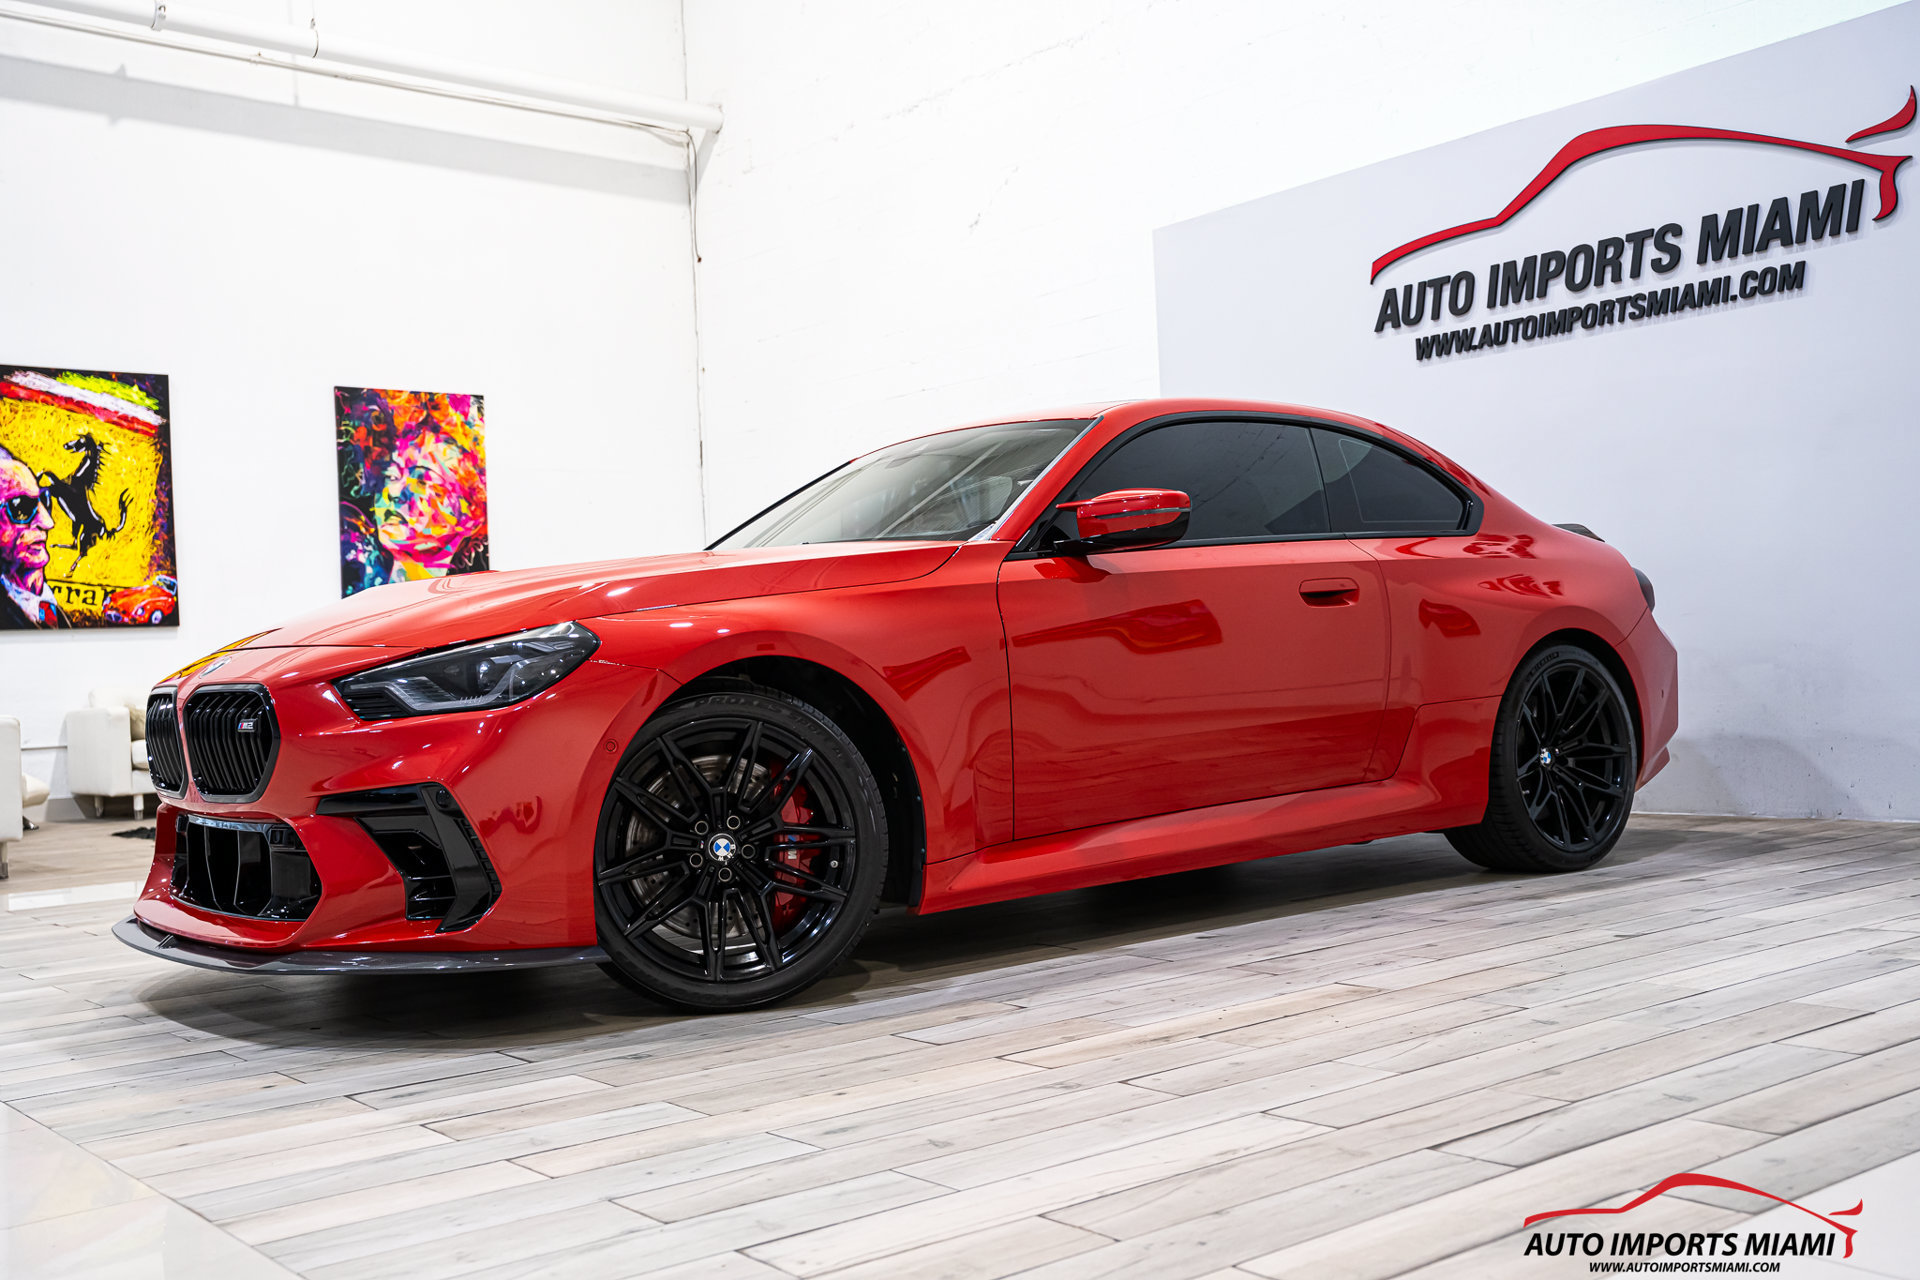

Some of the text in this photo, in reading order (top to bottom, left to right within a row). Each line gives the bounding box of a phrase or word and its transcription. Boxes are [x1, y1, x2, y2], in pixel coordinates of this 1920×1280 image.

[1375, 178, 1866, 333] AUTO IMPORTS MIAMI
[1414, 260, 1807, 361] WWW.AUTOIMPORTSMIAMI.COM
